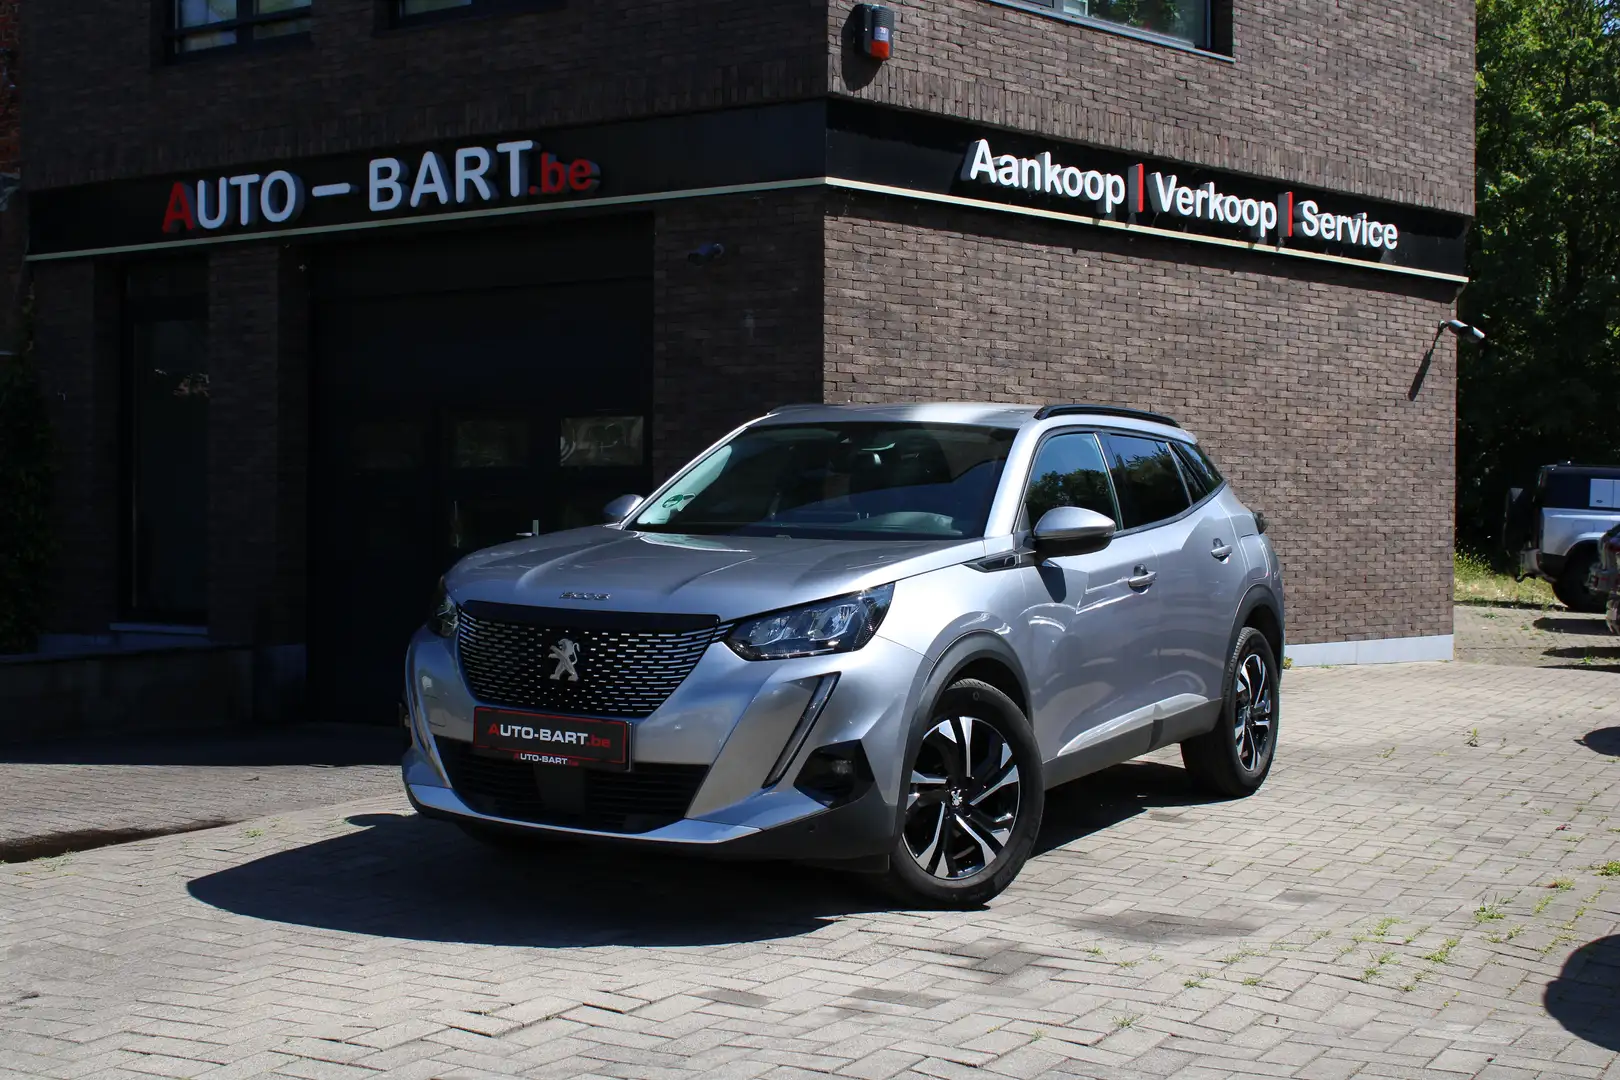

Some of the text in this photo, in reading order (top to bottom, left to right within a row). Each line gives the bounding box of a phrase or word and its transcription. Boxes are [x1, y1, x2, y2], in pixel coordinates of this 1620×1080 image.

[161, 169, 299, 234] AUTO
[968, 138, 1399, 251] Aankoop Verkoop Service
[487, 722, 612, 748] AUTO-BART.be
